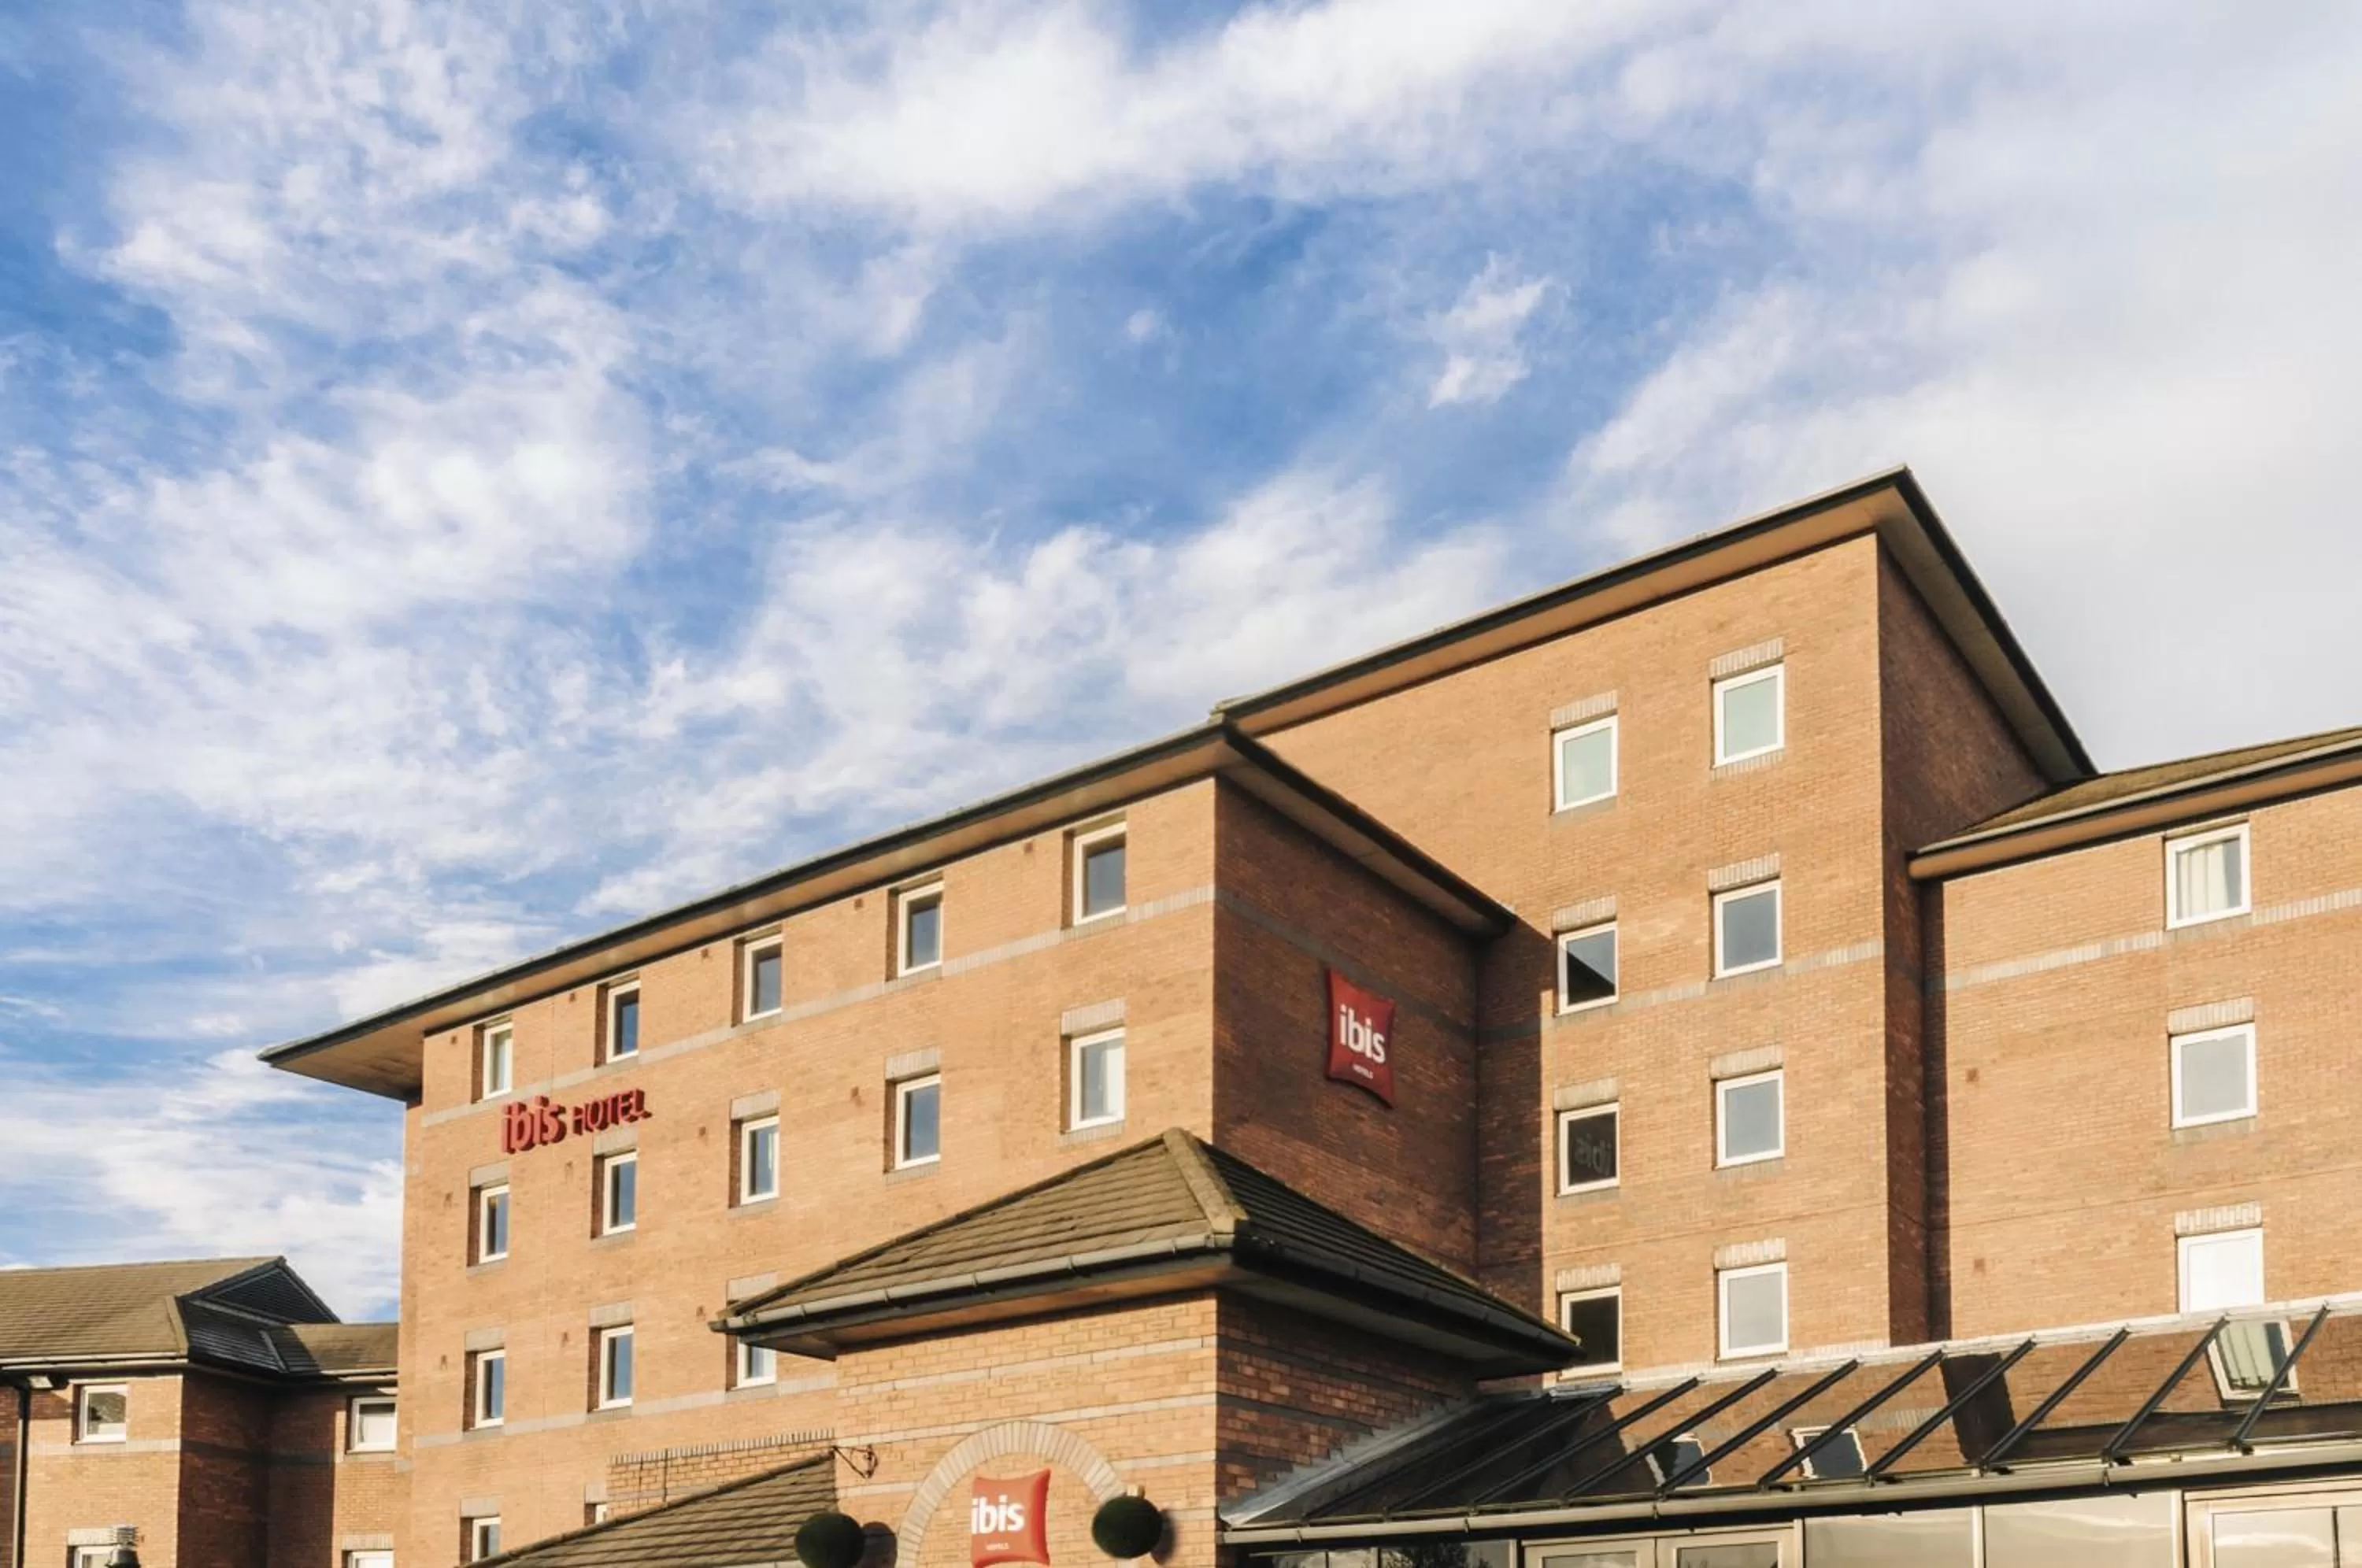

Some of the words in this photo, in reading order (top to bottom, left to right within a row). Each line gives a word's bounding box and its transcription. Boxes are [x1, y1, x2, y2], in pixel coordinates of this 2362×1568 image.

[1339, 1004, 1386, 1063] ibis
[501, 1095, 567, 1154] ibis
[572, 1089, 652, 1136] HOTEL
[971, 1495, 1026, 1534] ibis
